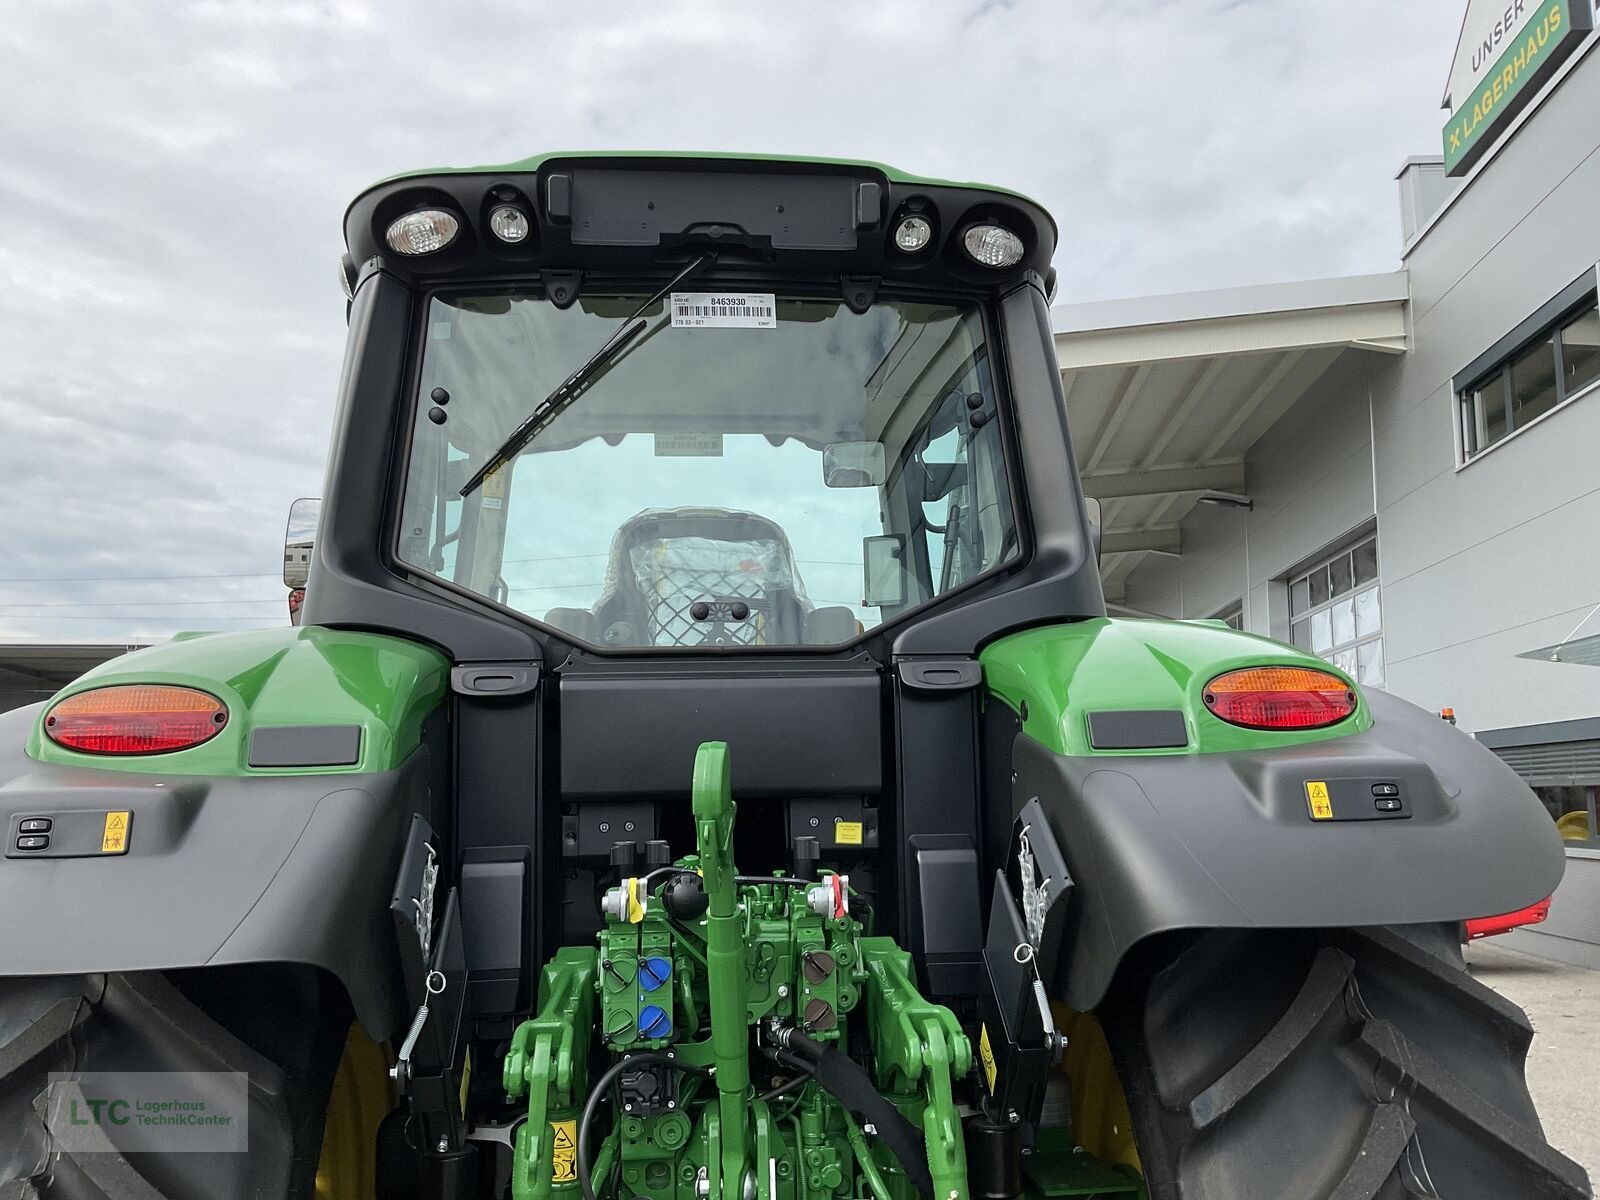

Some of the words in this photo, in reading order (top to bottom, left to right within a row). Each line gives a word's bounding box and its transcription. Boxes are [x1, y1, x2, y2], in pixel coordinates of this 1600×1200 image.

[1472, 0, 1524, 72] UNSER
[1463, 6, 1561, 139] LAGERHAUS
[711, 298, 746, 306] 8463930
